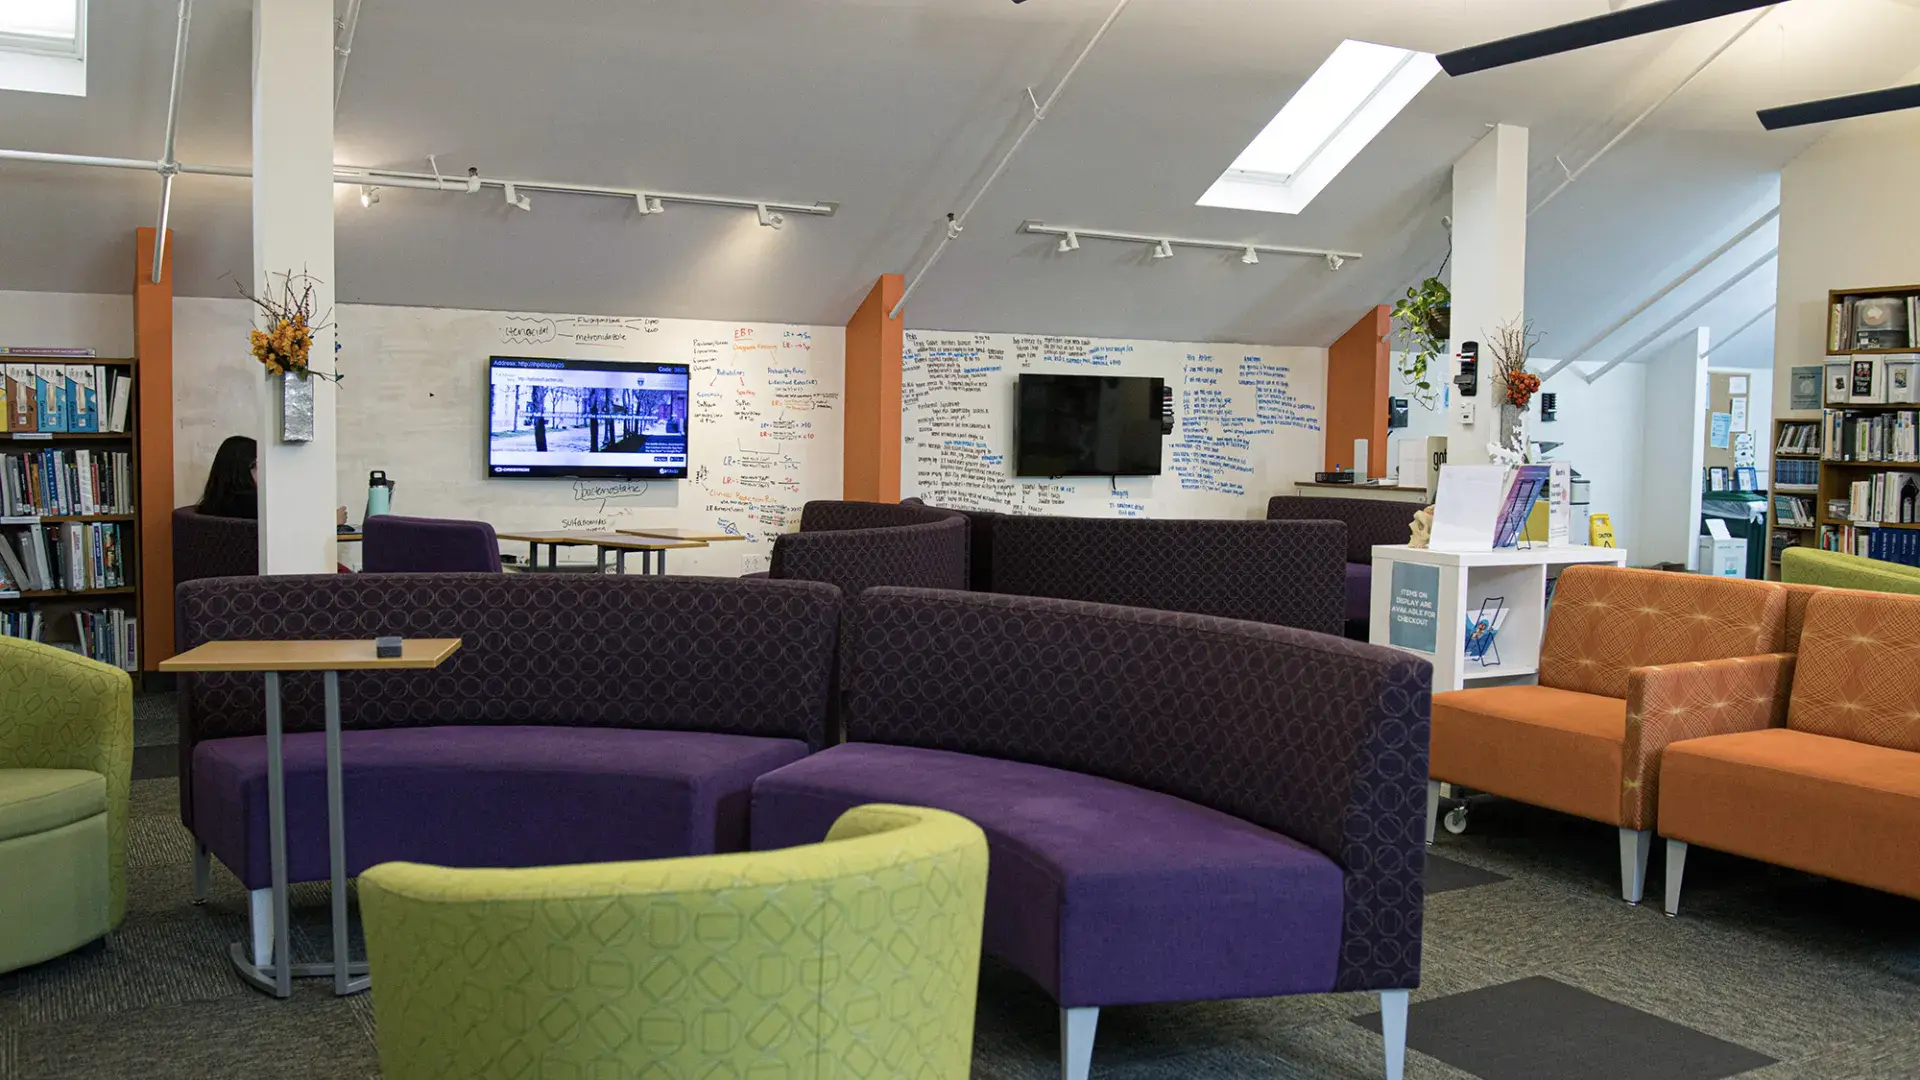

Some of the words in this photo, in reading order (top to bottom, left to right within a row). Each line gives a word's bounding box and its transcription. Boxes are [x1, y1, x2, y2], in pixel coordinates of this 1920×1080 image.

[734, 328, 754, 338] EBP
[1400, 588, 1417, 597] ITEMS
[1418, 591, 1428, 599] ON
[1396, 596, 1419, 606] DISPLAY
[1419, 600, 1433, 609] ARE
[1391, 606, 1423, 616] AVAILABLE
[1397, 615, 1429, 626] CHECKOUT
